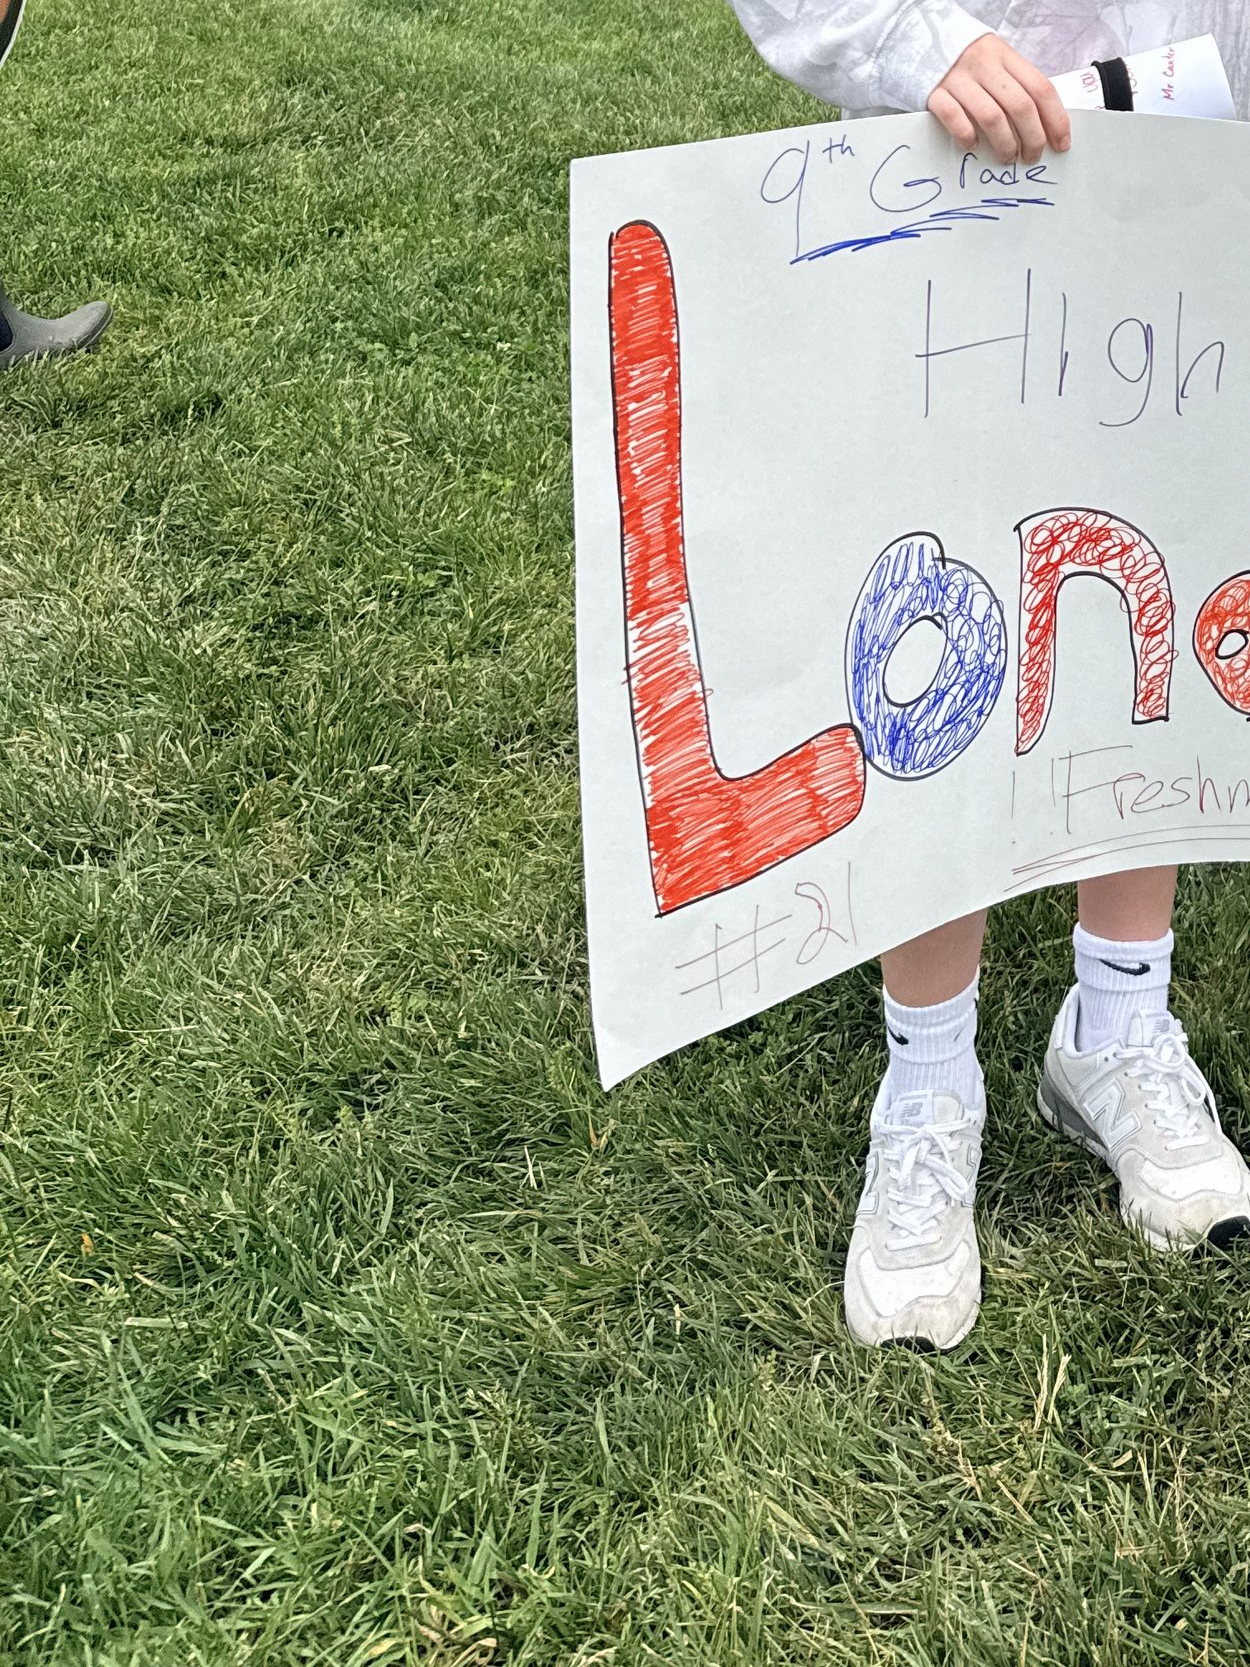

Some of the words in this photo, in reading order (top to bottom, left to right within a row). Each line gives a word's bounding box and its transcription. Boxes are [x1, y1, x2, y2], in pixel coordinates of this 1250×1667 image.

[1160, 82, 1175, 101] Mr
[760, 134, 856, 258] 9th
[869, 144, 1058, 214] Grade
[674, 861, 857, 1010] #21
